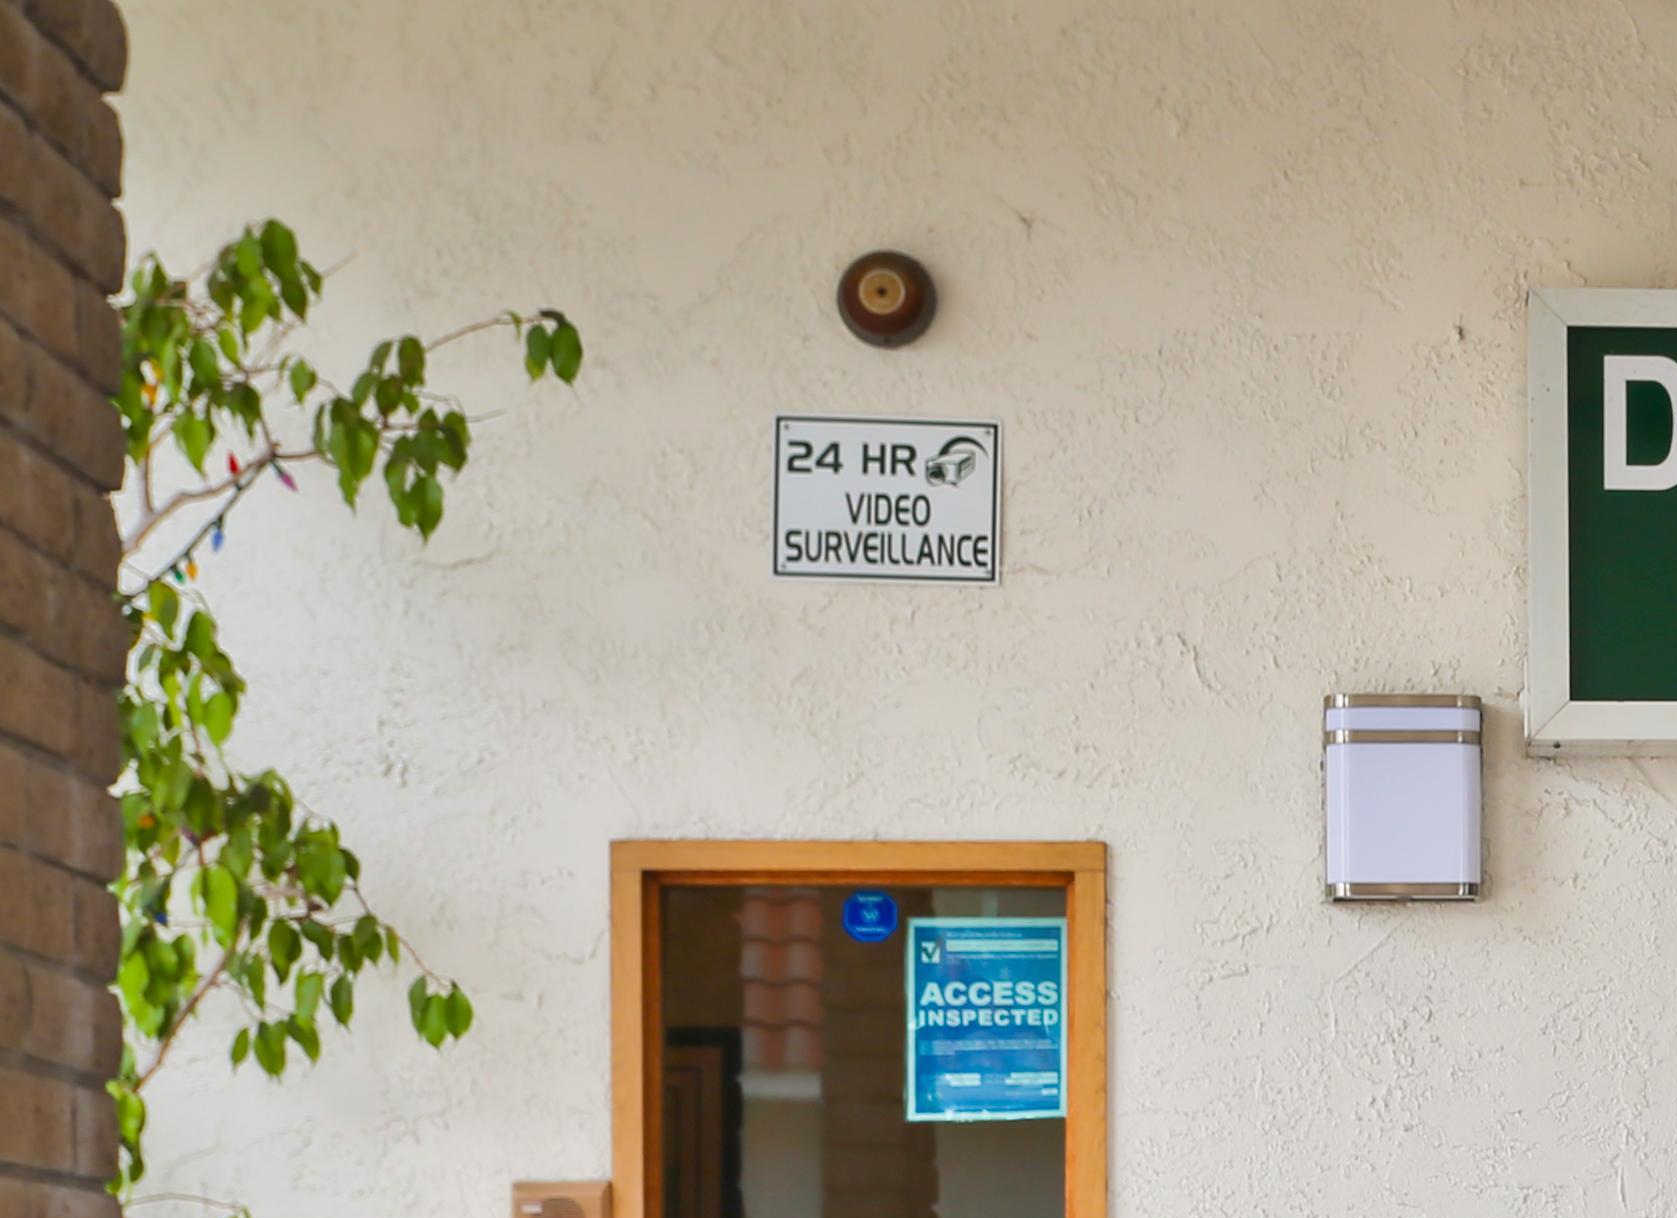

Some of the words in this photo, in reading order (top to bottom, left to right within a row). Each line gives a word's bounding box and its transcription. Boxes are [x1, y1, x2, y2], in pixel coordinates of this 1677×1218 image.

[786, 440, 843, 474] 24
[862, 443, 917, 476] HR
[846, 493, 931, 527] VIDEO
[785, 530, 988, 567] SURVEILLANCE
[920, 981, 1059, 1006] ACCESS
[918, 1008, 1059, 1027] INSPECTED
